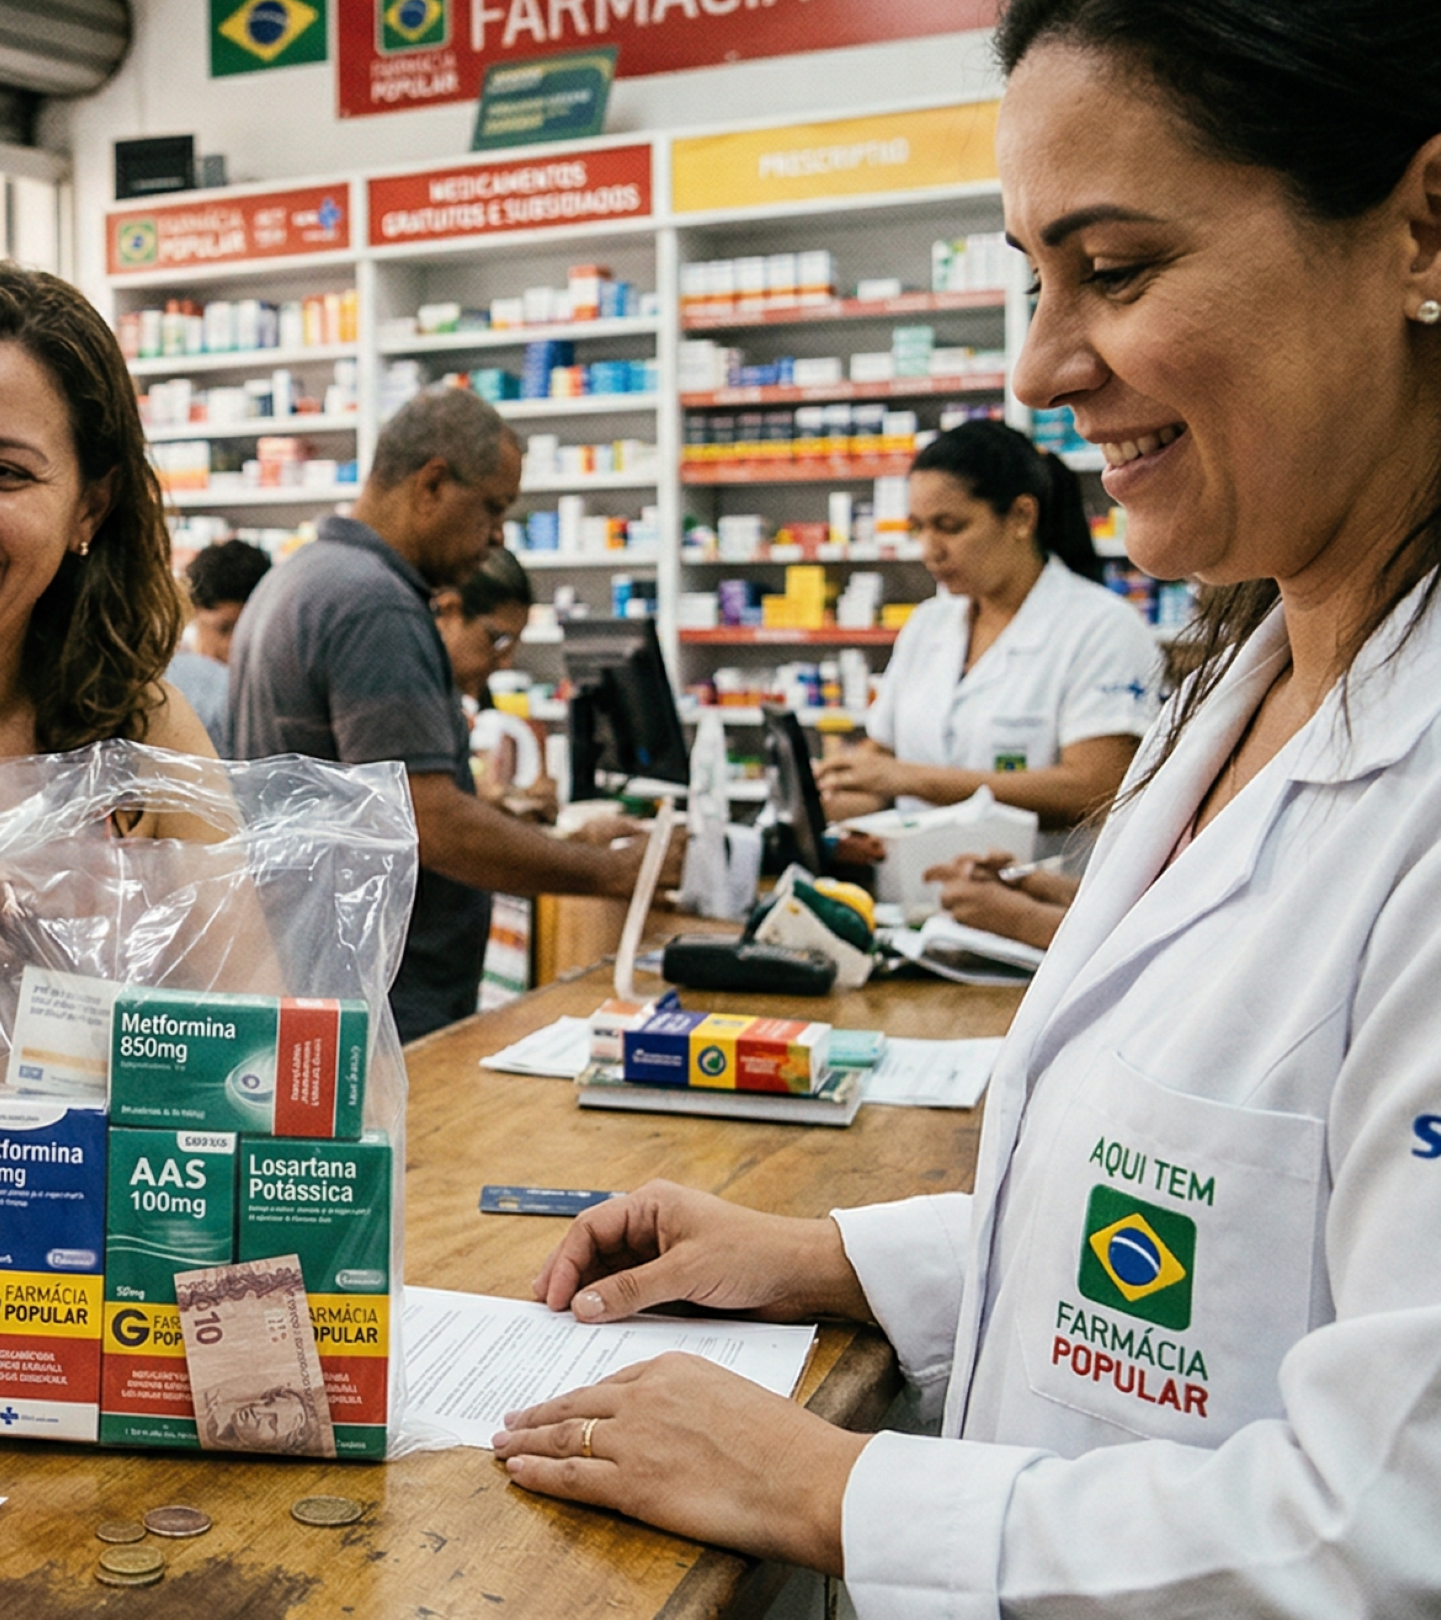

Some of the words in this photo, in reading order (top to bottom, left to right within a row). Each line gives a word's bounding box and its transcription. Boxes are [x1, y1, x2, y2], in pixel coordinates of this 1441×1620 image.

[121, 1012, 237, 1039] Metformina
[120, 1035, 188, 1063] 850mg
[129, 1157, 207, 1190] AAS
[249, 1154, 357, 1179] Losartana
[1089, 1136, 1147, 1184] AQUI
[1154, 1157, 1216, 1207] TEM
[249, 1177, 354, 1202] Potássica
[130, 1190, 207, 1219] 100mg
[5, 1282, 89, 1306] FARMÁCIA
[4, 1303, 89, 1325] POPULAR
[111, 1308, 150, 1347] G
[194, 1311, 223, 1345] 10
[1056, 1301, 1210, 1382] FARMÁCIA
[1051, 1335, 1210, 1419] POPULAR
